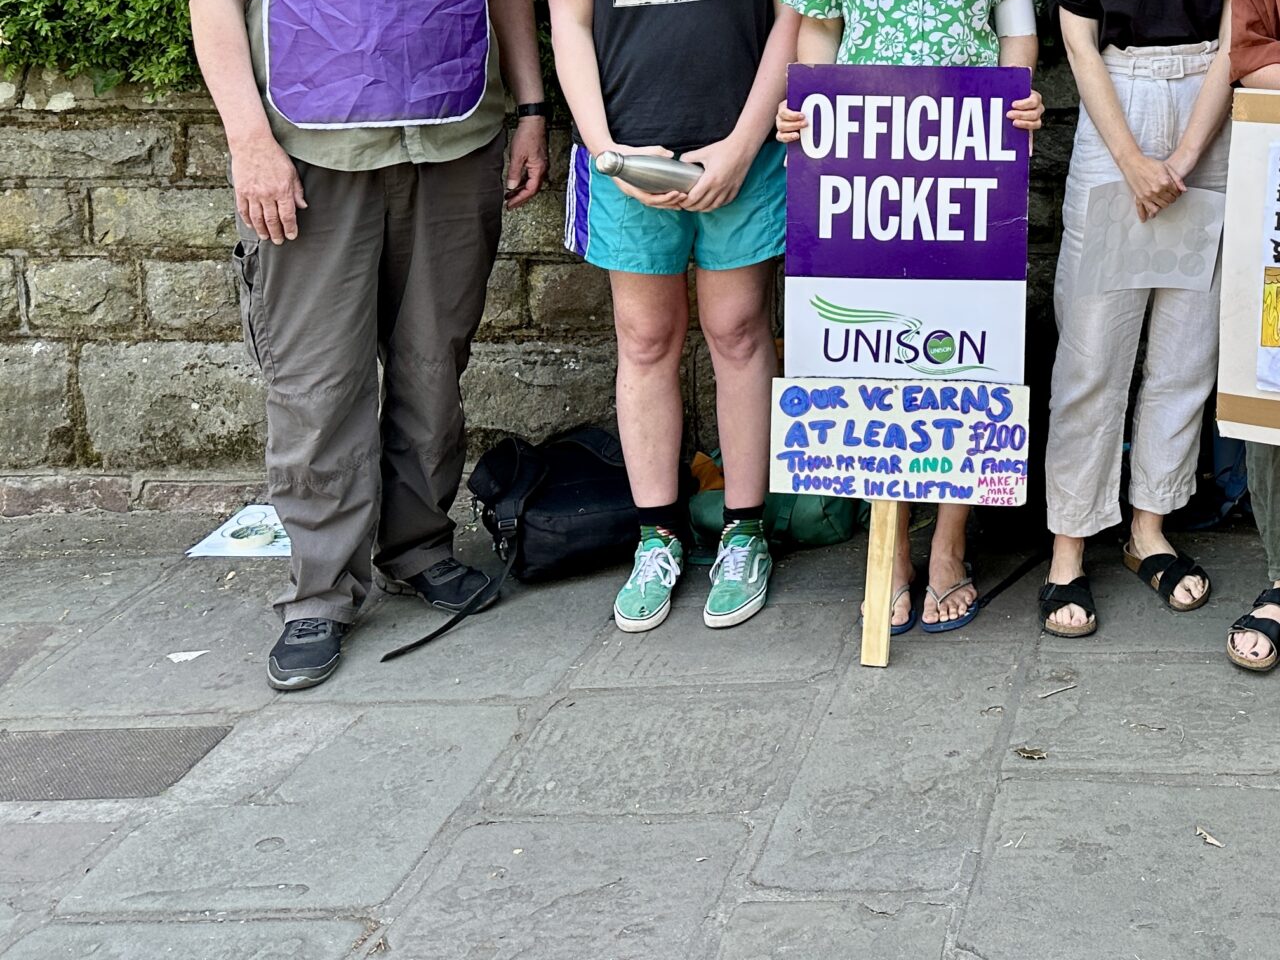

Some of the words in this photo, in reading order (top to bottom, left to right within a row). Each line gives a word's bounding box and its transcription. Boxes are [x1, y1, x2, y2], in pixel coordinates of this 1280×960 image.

[800, 93, 1016, 162] OFFICIAL
[818, 175, 998, 241] PICKET
[823, 327, 987, 365] UNISON
[779, 385, 849, 418] OUR
[859, 385, 894, 412] VC
[902, 385, 1014, 423] EARNS
[784, 419, 836, 449] AT
[843, 418, 964, 453] LEAST
[966, 421, 1026, 456] £200
[858, 454, 903, 474] YEAR
[909, 456, 953, 473] AND
[960, 457, 975, 473] A
[978, 476, 1012, 488] MAKE
[1015, 477, 1027, 486] IT
[792, 475, 856, 496] HOUSE
[864, 478, 885, 496] IN
[886, 479, 974, 499] CLIFTON
[987, 487, 1015, 496] MAKE
